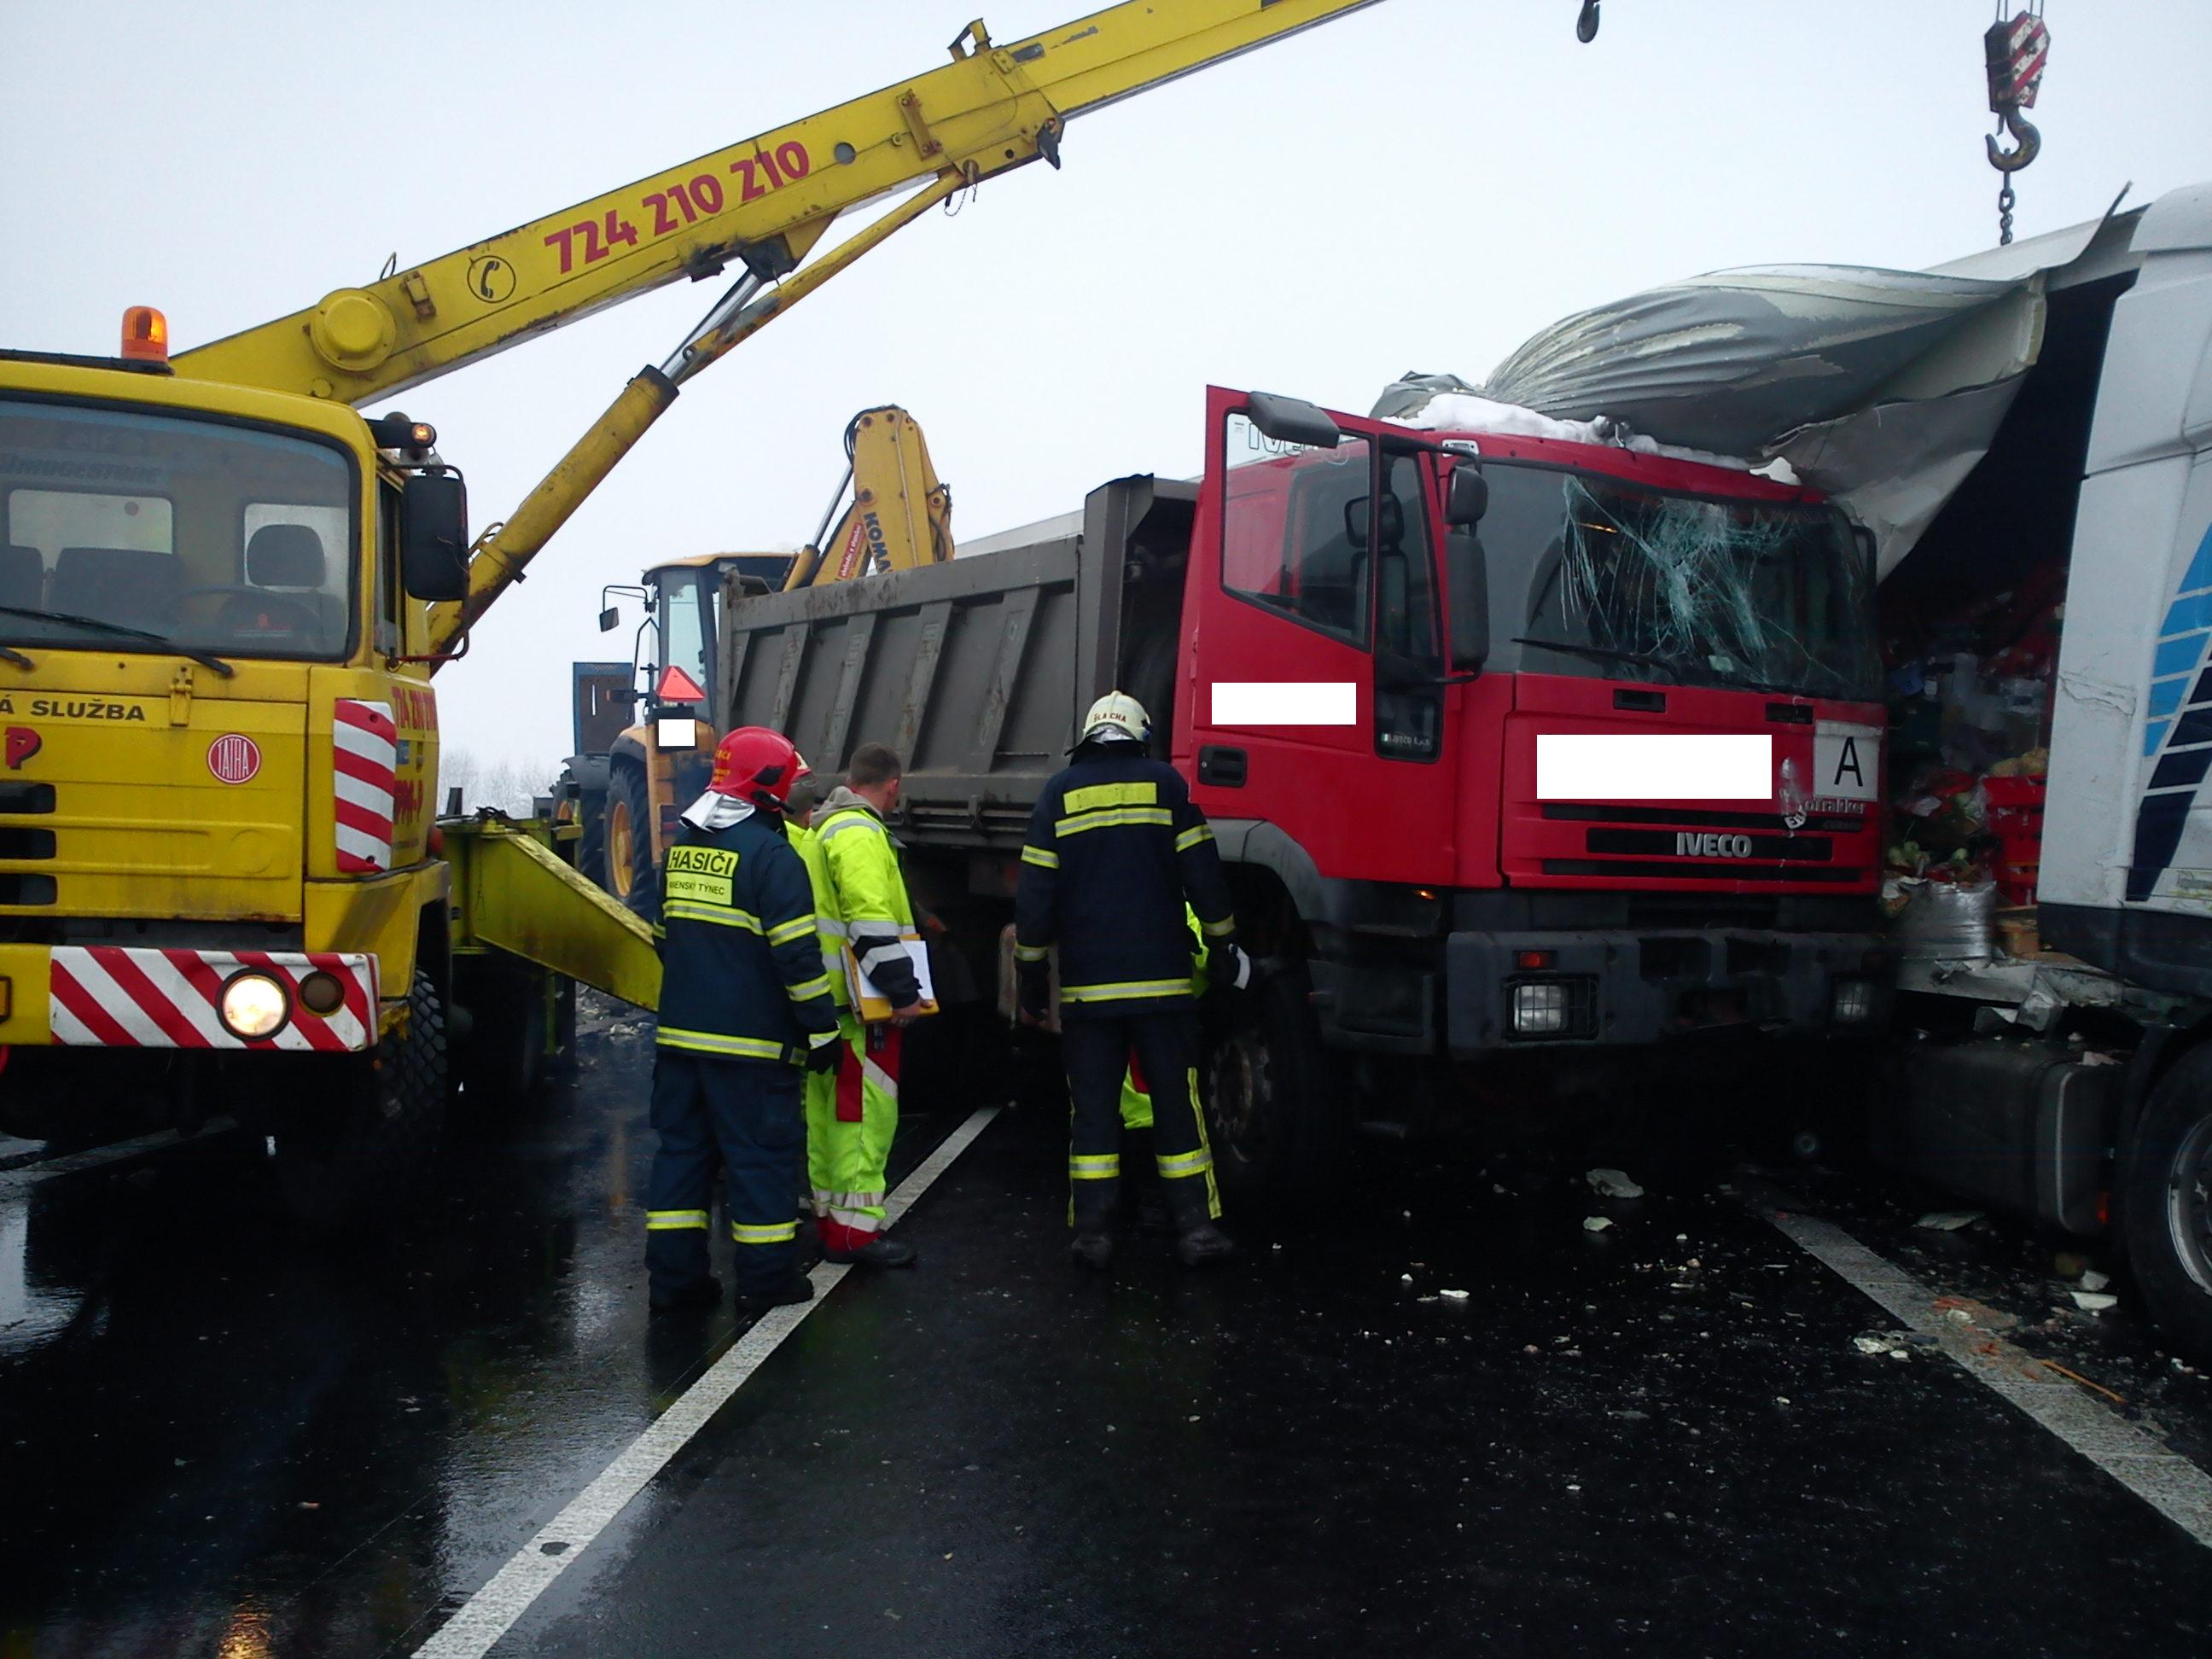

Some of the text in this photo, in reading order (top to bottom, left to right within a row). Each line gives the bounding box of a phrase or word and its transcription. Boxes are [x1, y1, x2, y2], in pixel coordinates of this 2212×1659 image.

[544, 141, 810, 275] 724 210 210
[863, 511, 893, 574] KOMA
[30, 698, 145, 721] SLUŽBA
[218, 739, 249, 779] TATRA
[1834, 736, 1864, 787] A
[1676, 832, 1752, 858] IVECO
[669, 851, 733, 875] HASIČI
[699, 882, 725, 895] TÝNEC
